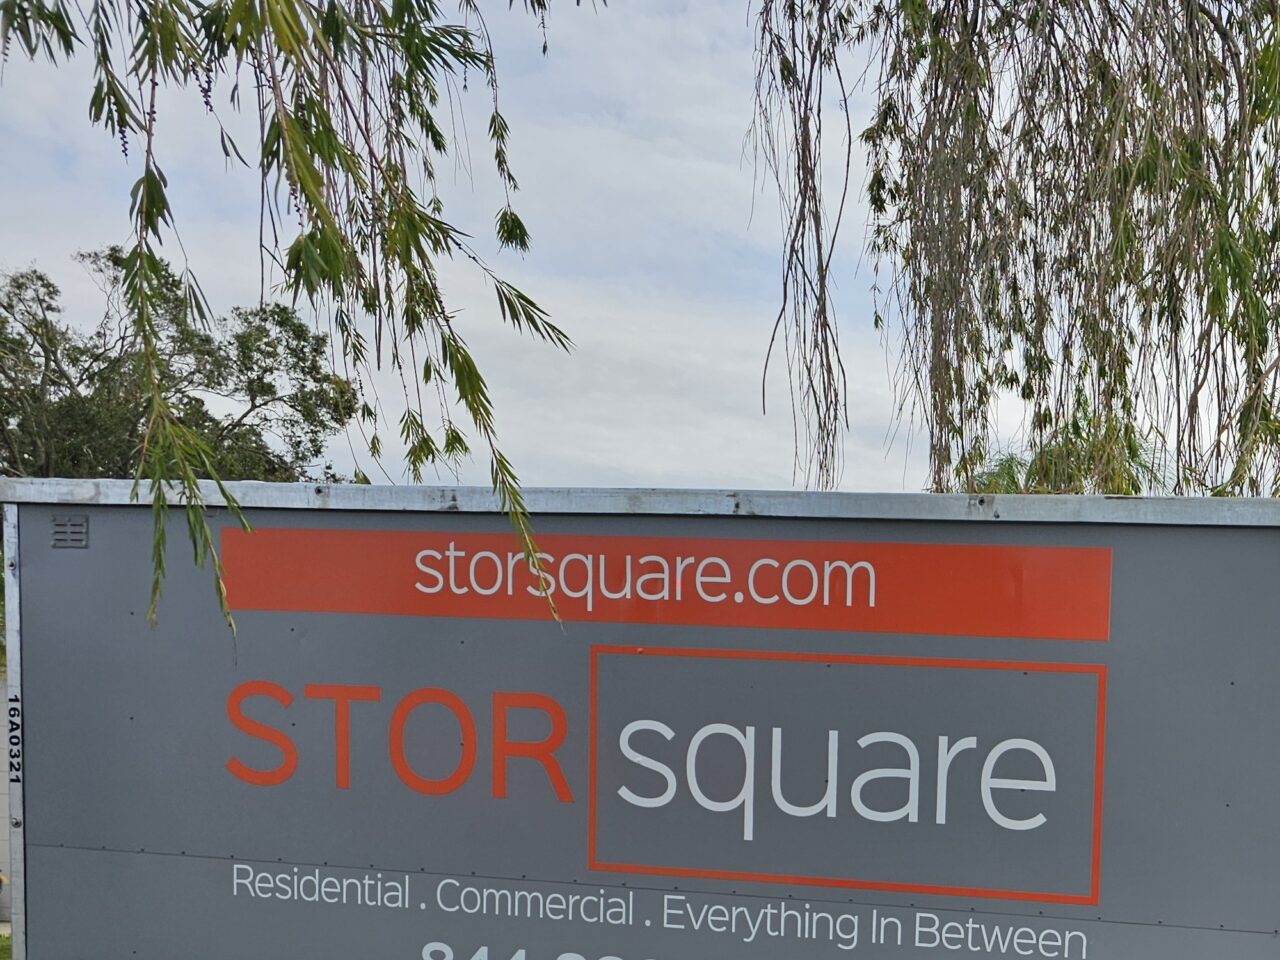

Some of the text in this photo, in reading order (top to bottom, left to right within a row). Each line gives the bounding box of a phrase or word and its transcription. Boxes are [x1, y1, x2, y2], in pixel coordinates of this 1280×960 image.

[414, 541, 876, 611] storsquare.com
[8, 694, 22, 784] 16A0321
[226, 680, 1057, 841] STOR square
[233, 864, 410, 909] Residential
[435, 878, 634, 926] Commercial
[663, 894, 859, 949] Everything
[871, 908, 902, 945] In
[915, 912, 1088, 960] Between
